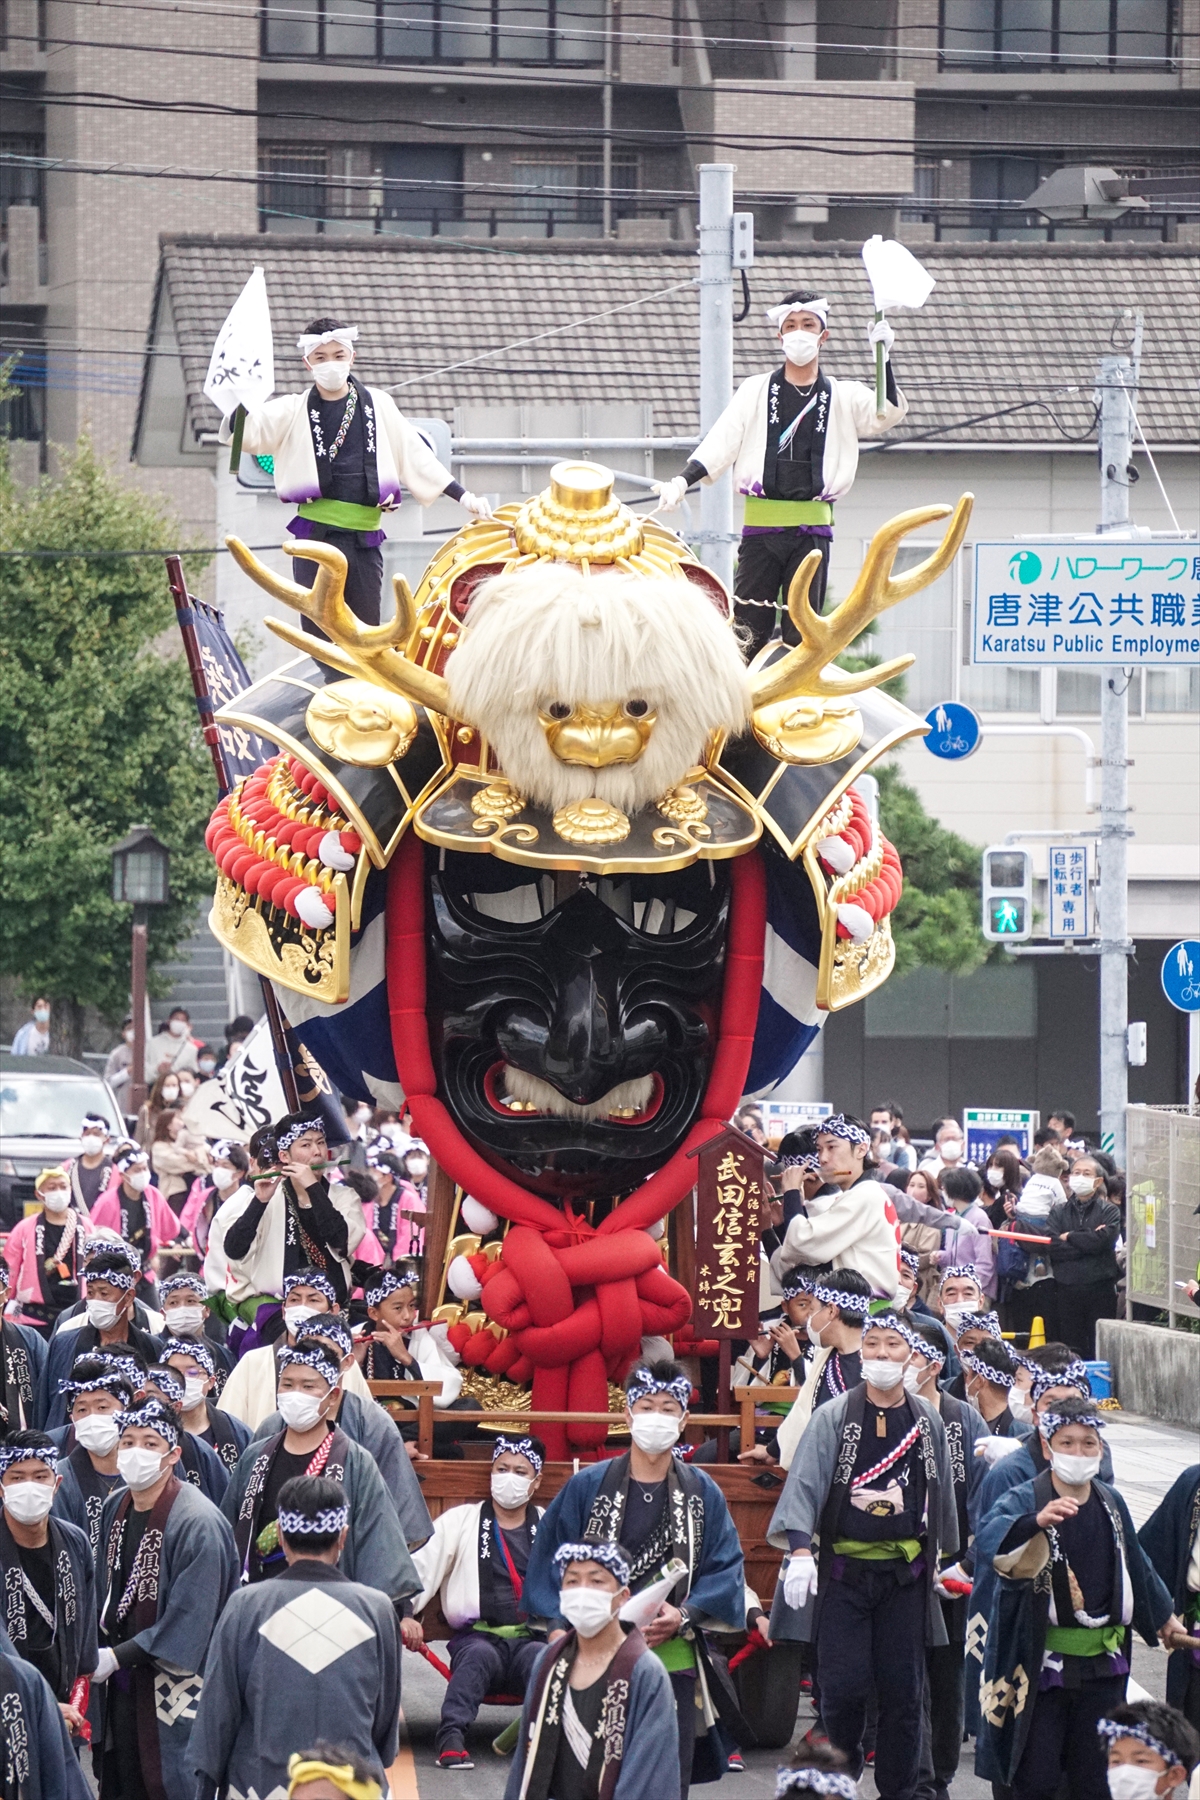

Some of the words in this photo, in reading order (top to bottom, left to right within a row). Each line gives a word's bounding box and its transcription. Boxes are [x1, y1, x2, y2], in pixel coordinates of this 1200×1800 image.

[1050, 556, 1188, 581] ハローワーク
[986, 592, 1200, 627] 唐津公共職
[982, 634, 1046, 652] Karatsu
[1053, 634, 1104, 652] Public
[1054, 852, 1067, 897] 自転車
[1070, 852, 1083, 897] 歩行者
[1062, 900, 1075, 931] 専用
[711, 1151, 748, 1330] 武田信玄之兜
